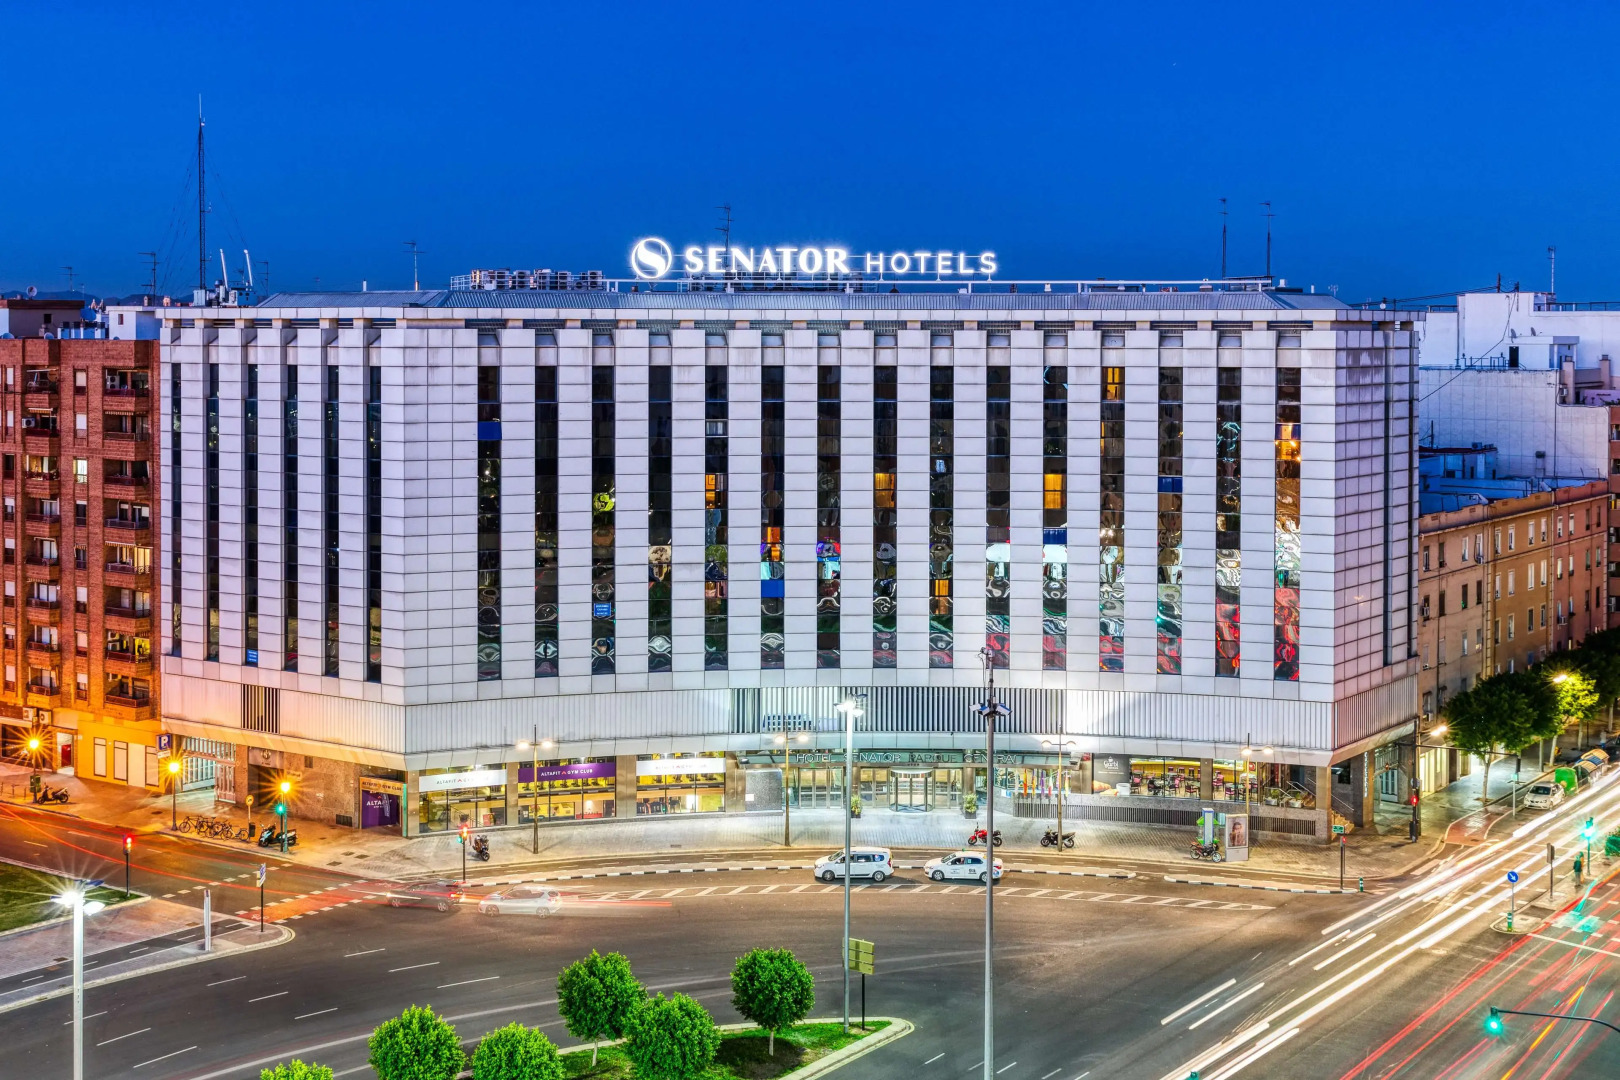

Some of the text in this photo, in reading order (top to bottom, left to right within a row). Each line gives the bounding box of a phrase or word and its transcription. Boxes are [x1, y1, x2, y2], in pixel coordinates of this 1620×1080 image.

[685, 247, 997, 274] SENATOR HOTELS
[796, 753, 833, 763] HOTEL
[908, 753, 957, 764] PARQUE
